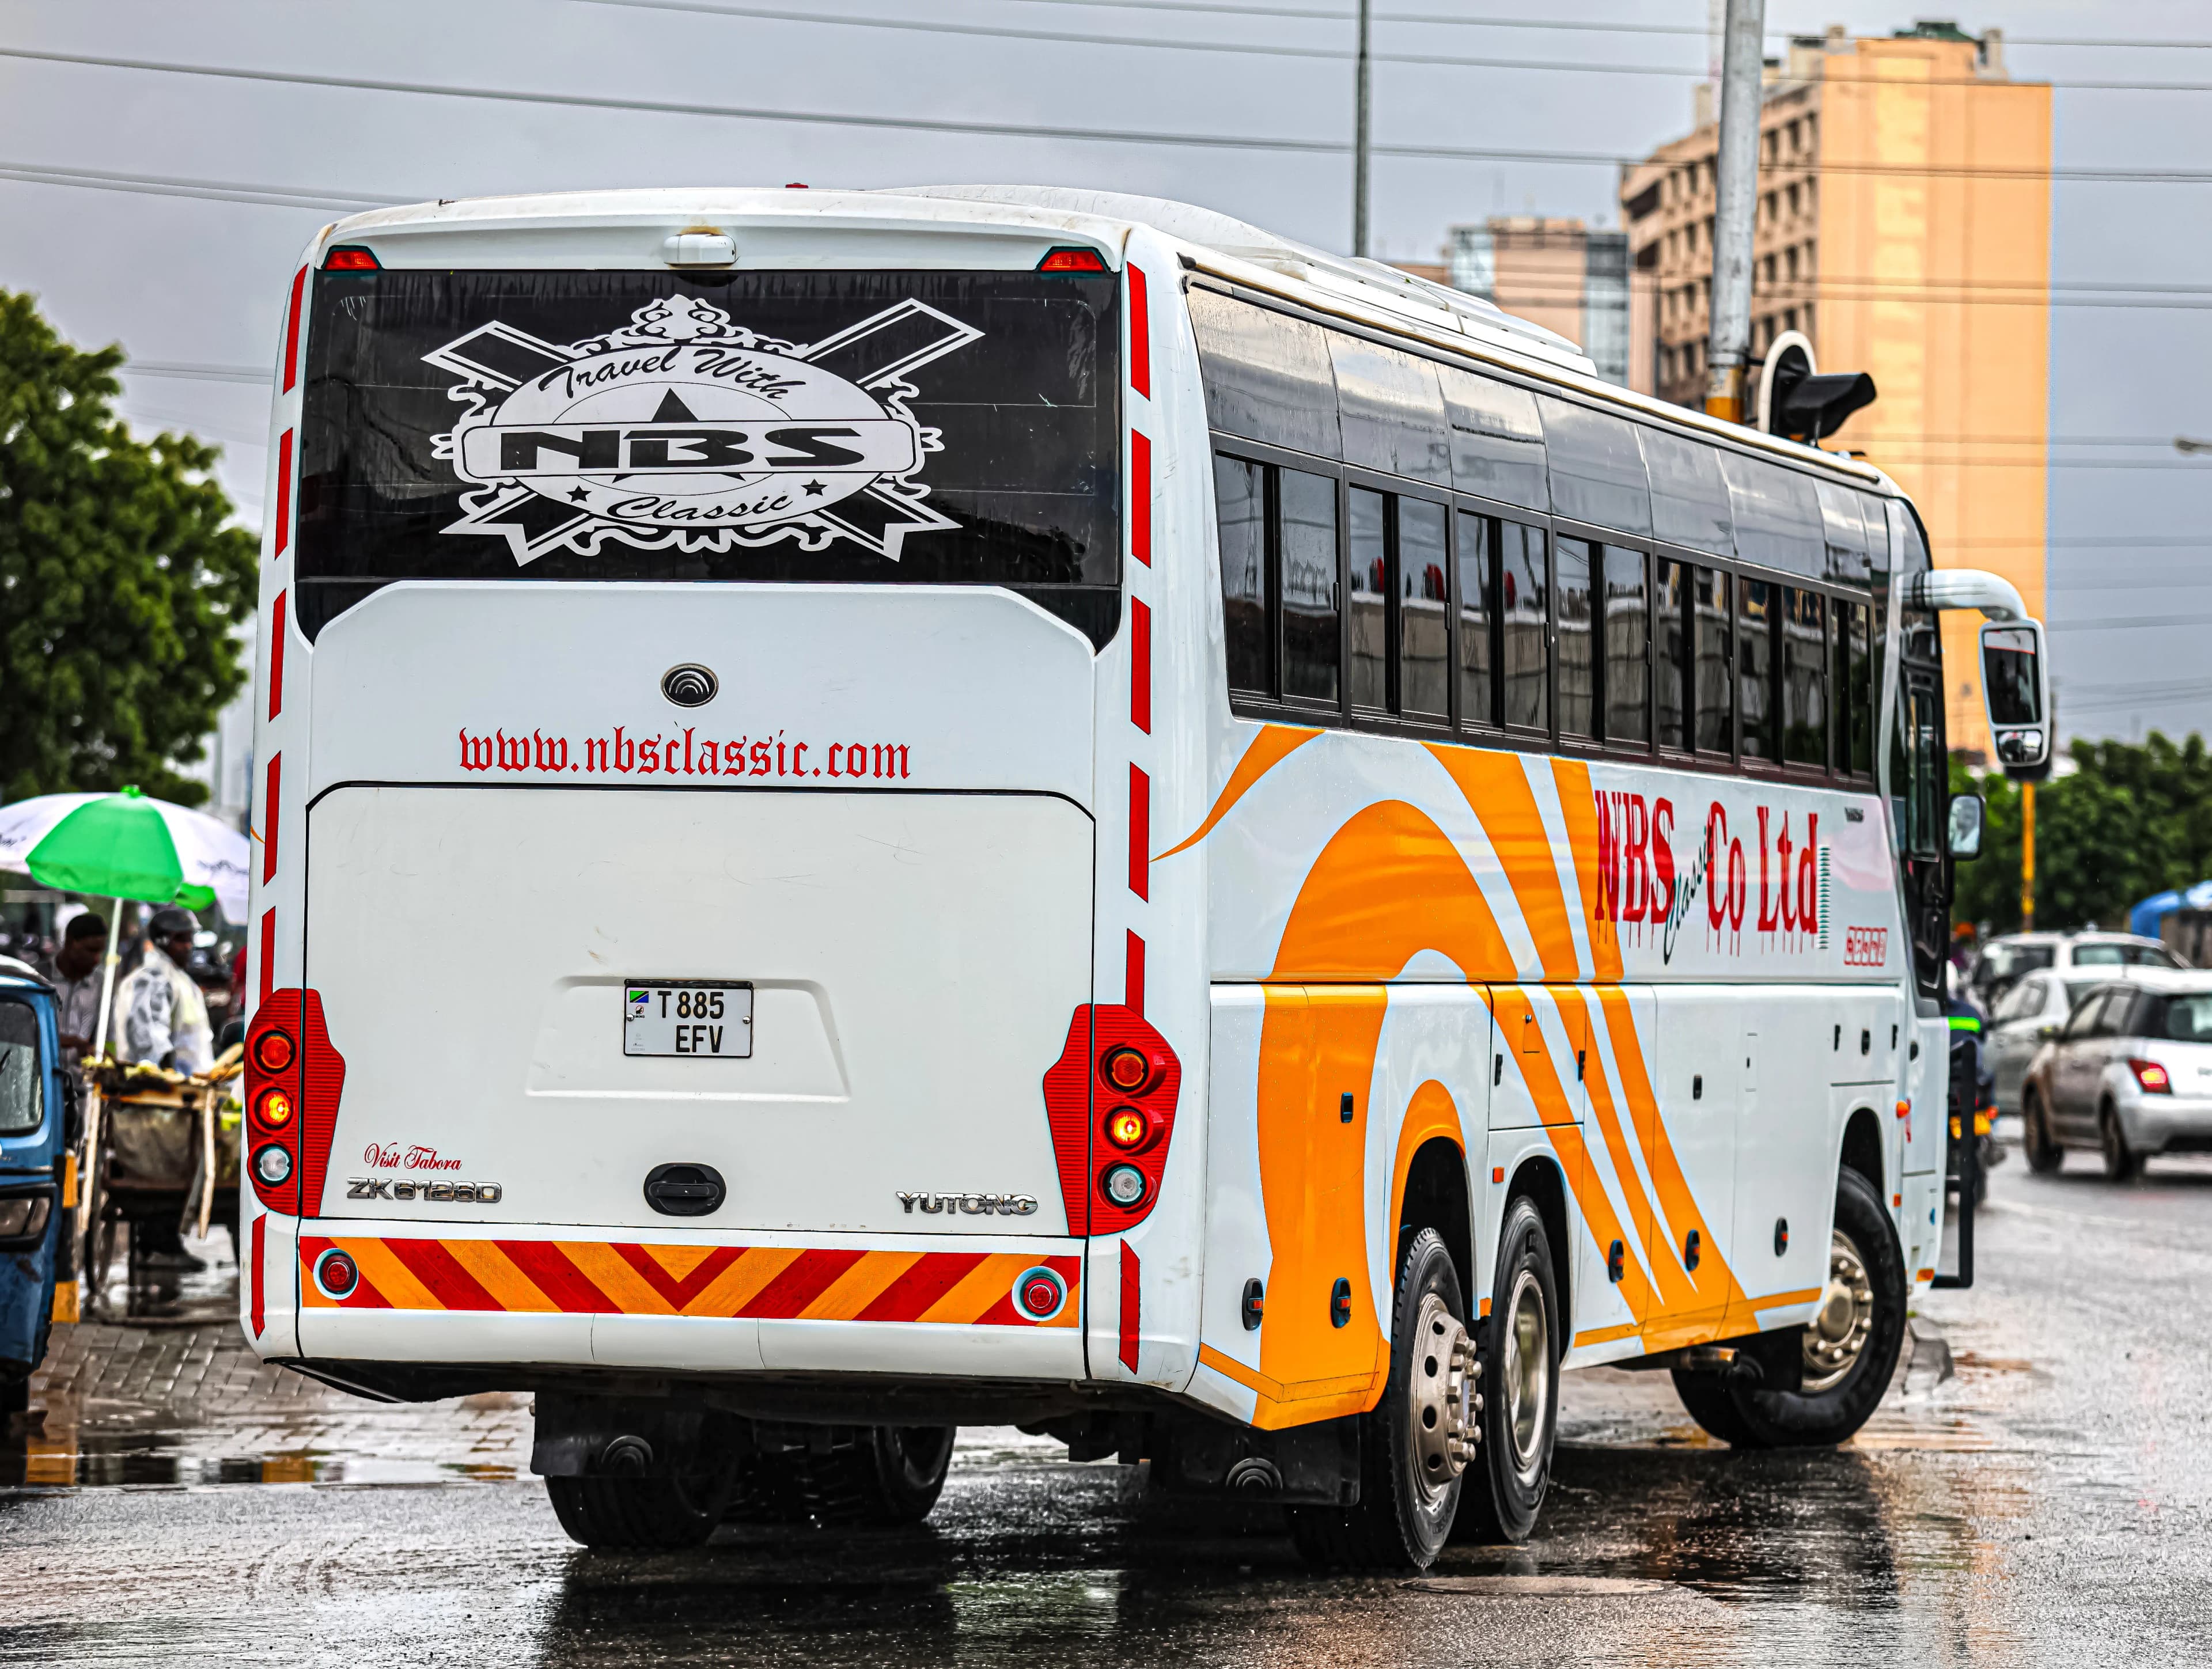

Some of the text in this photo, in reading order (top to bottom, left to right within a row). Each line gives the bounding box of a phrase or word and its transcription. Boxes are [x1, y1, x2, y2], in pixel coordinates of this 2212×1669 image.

[537, 346, 806, 400] Travel With
[500, 426, 866, 471] NBS
[607, 494, 793, 522] Classic
[459, 725, 911, 780] www.nbsclassic.com
[1594, 790, 1675, 925] NBS
[1706, 801, 1747, 932] Co
[1756, 806, 1819, 934] Ltd
[657, 990, 724, 1019] T 885
[675, 1025, 724, 1053] EFV
[363, 1142, 463, 1171] Visit Tabora
[346, 1177, 502, 1204] ZK6126D
[895, 1190, 1039, 1216] YUTONG
